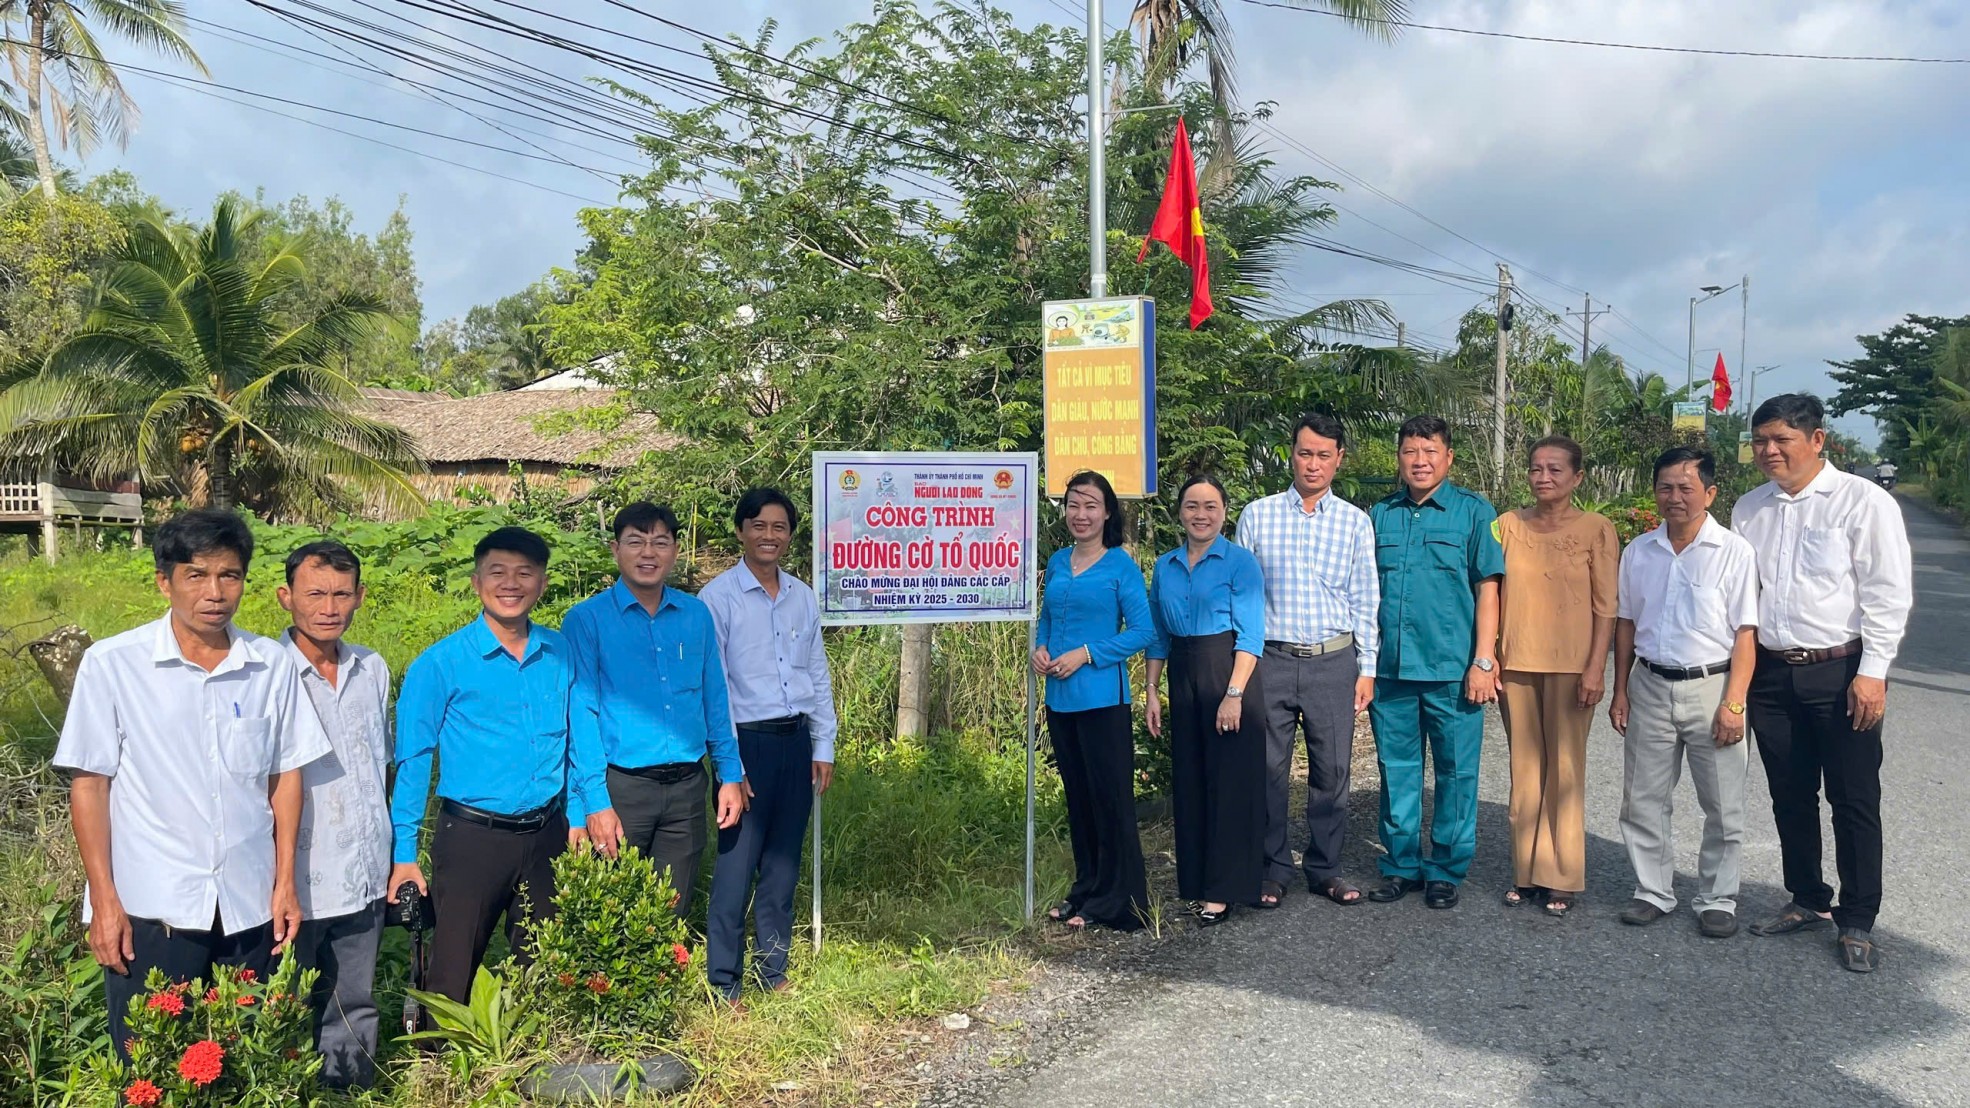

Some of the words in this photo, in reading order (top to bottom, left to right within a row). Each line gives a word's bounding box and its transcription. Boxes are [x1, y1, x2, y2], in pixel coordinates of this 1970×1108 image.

[1094, 365, 1112, 390] MỤC
[1114, 361, 1132, 386] TIÊU
[1051, 398, 1068, 422] DÂN
[1091, 396, 1113, 421] NƯỚC
[1115, 399, 1139, 424] MẠNH
[1054, 432, 1070, 456] DÂN
[1091, 431, 1113, 455] CÔNG
[1115, 427, 1137, 455] BẰNG
[942, 486, 958, 498] LAO
[866, 501, 927, 527] CÔNG
[933, 501, 995, 526] TRÌNH
[833, 535, 901, 570] ĐƯỜNG
[908, 535, 934, 569] CỜ
[940, 532, 963, 569] TỔ
[969, 532, 1019, 571] QUỐC
[842, 576, 868, 588] CHÀO
[871, 576, 900, 588] MỪNG
[903, 577, 919, 590] ĐẠI
[922, 576, 938, 590] HỘI
[941, 574, 967, 588] ĐẢNG
[970, 575, 989, 588] CÁC
[991, 573, 1010, 587] CẤP
[874, 592, 906, 607] NHIỆM
[909, 592, 921, 605] KỲ
[924, 594, 947, 604] 2025
[956, 593, 979, 604] 2030
